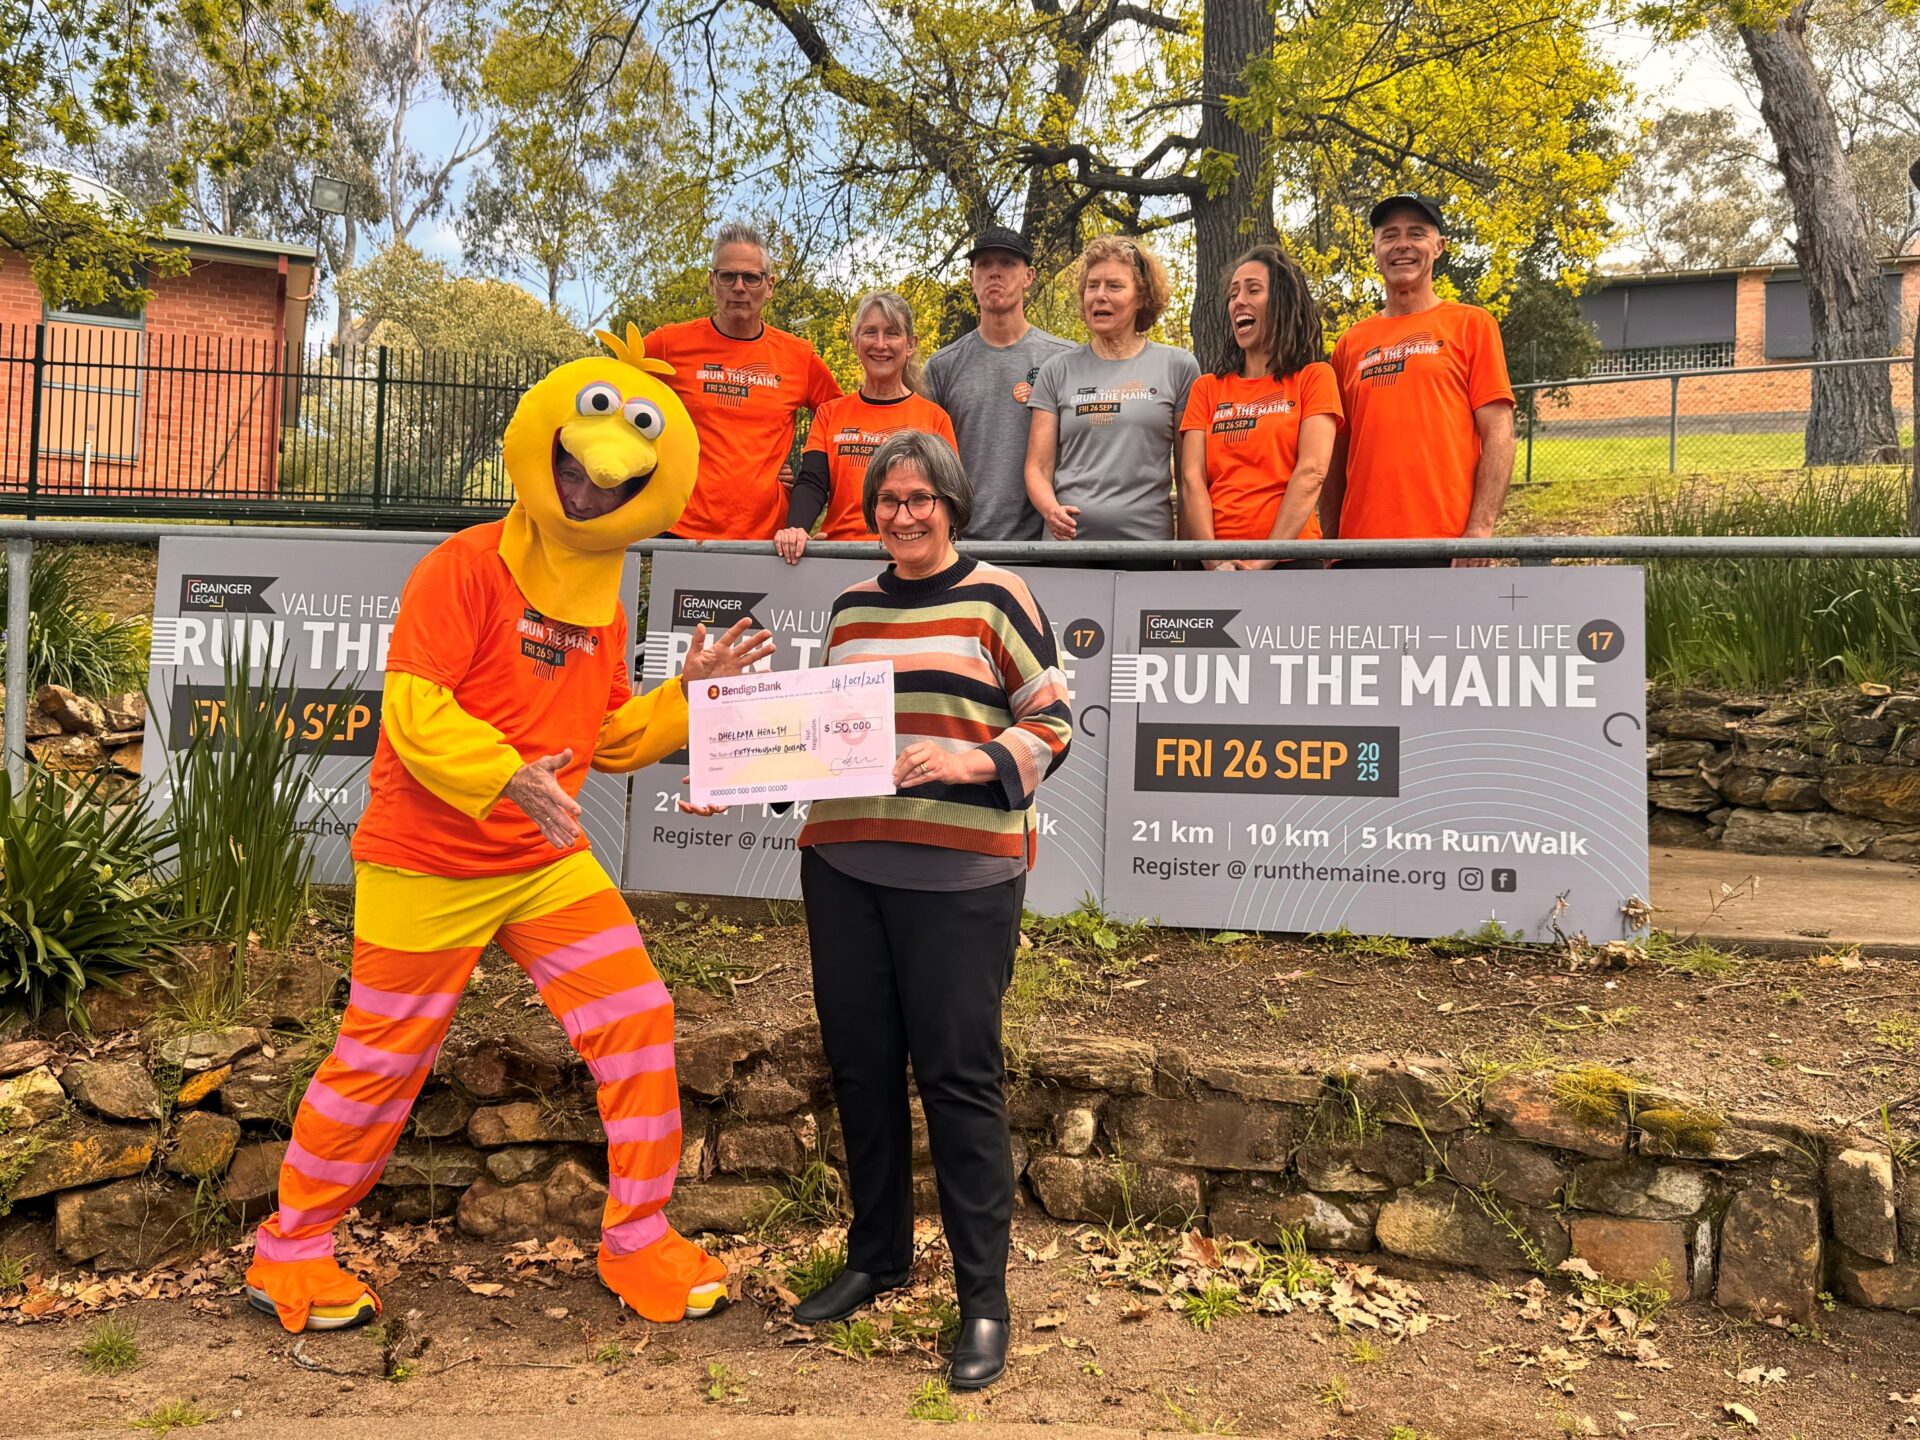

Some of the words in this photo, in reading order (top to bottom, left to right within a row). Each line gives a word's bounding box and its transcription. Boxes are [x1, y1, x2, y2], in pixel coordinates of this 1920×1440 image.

[1384, 348, 1402, 361] THE
[1405, 344, 1438, 356] MAINE
[1374, 365, 1382, 374] 26
[1383, 363, 1397, 372] SEP
[704, 370, 724, 381] RUN
[726, 372, 746, 384] THE
[748, 375, 779, 388] MAINE
[706, 384, 718, 392] FRI
[719, 385, 727, 393] 26
[728, 386, 741, 394] SEP
[1076, 393, 1097, 403] RUN
[1099, 392, 1119, 401] THE
[1121, 391, 1153, 401] MAINE
[1078, 405, 1089, 413] FRI
[1090, 404, 1099, 412] 26
[1099, 404, 1113, 412] SEP
[1236, 406, 1255, 416] THE
[1258, 403, 1291, 415] MAINE
[1226, 421, 1233, 430] 26
[1234, 419, 1248, 429] SEP
[839, 432, 858, 442] RUN
[861, 434, 880, 443] THE
[840, 446, 851, 454] FRI
[851, 445, 860, 453] 26
[860, 446, 873, 454] SEP
[191, 582, 252, 595] GRAINGER
[190, 594, 221, 604] LEGAL
[281, 592, 353, 617] VALUE
[683, 597, 743, 611] GRAINGER
[682, 609, 711, 619] LEGAL
[522, 621, 544, 640] RUN
[1150, 618, 1214, 629] GRAINGER
[174, 617, 285, 668] RUN
[1072, 629, 1096, 648] 17
[1149, 630, 1182, 640] LEGAL
[1245, 625, 1321, 649] VALUE
[1329, 624, 1420, 650] HEALTH
[1456, 624, 1509, 649] LIVE
[1518, 624, 1572, 649] LIFE
[1588, 631, 1614, 651] 17
[524, 642, 535, 656] FRI
[536, 645, 546, 659] 26
[1136, 653, 1251, 705] RUN
[1269, 654, 1380, 706] THE
[1400, 655, 1598, 708] MAINE
[721, 683, 757, 697] Bendigo
[758, 681, 782, 692] Bank
[757, 725, 787, 737] HEALTH
[824, 723, 830, 733] $
[833, 720, 872, 734] 50,000
[1155, 738, 1213, 777] FRI
[1223, 739, 1268, 779] 26
[1274, 740, 1348, 780] SEP
[1357, 742, 1380, 761] 20
[1357, 762, 1380, 782] 25
[308, 781, 349, 805] km
[738, 786, 750, 794] 000
[653, 825, 733, 849] Register
[739, 831, 757, 850] @
[1131, 819, 1161, 843] 21
[1171, 820, 1215, 844] km
[1246, 823, 1277, 846] 10
[1285, 823, 1329, 848] km
[1361, 826, 1377, 849] 5
[1386, 826, 1432, 851] km
[1442, 829, 1589, 856] Run/Walk
[1132, 856, 1221, 881] Register
[1227, 860, 1247, 879] @
[1253, 861, 1447, 891] runthemaine.org
